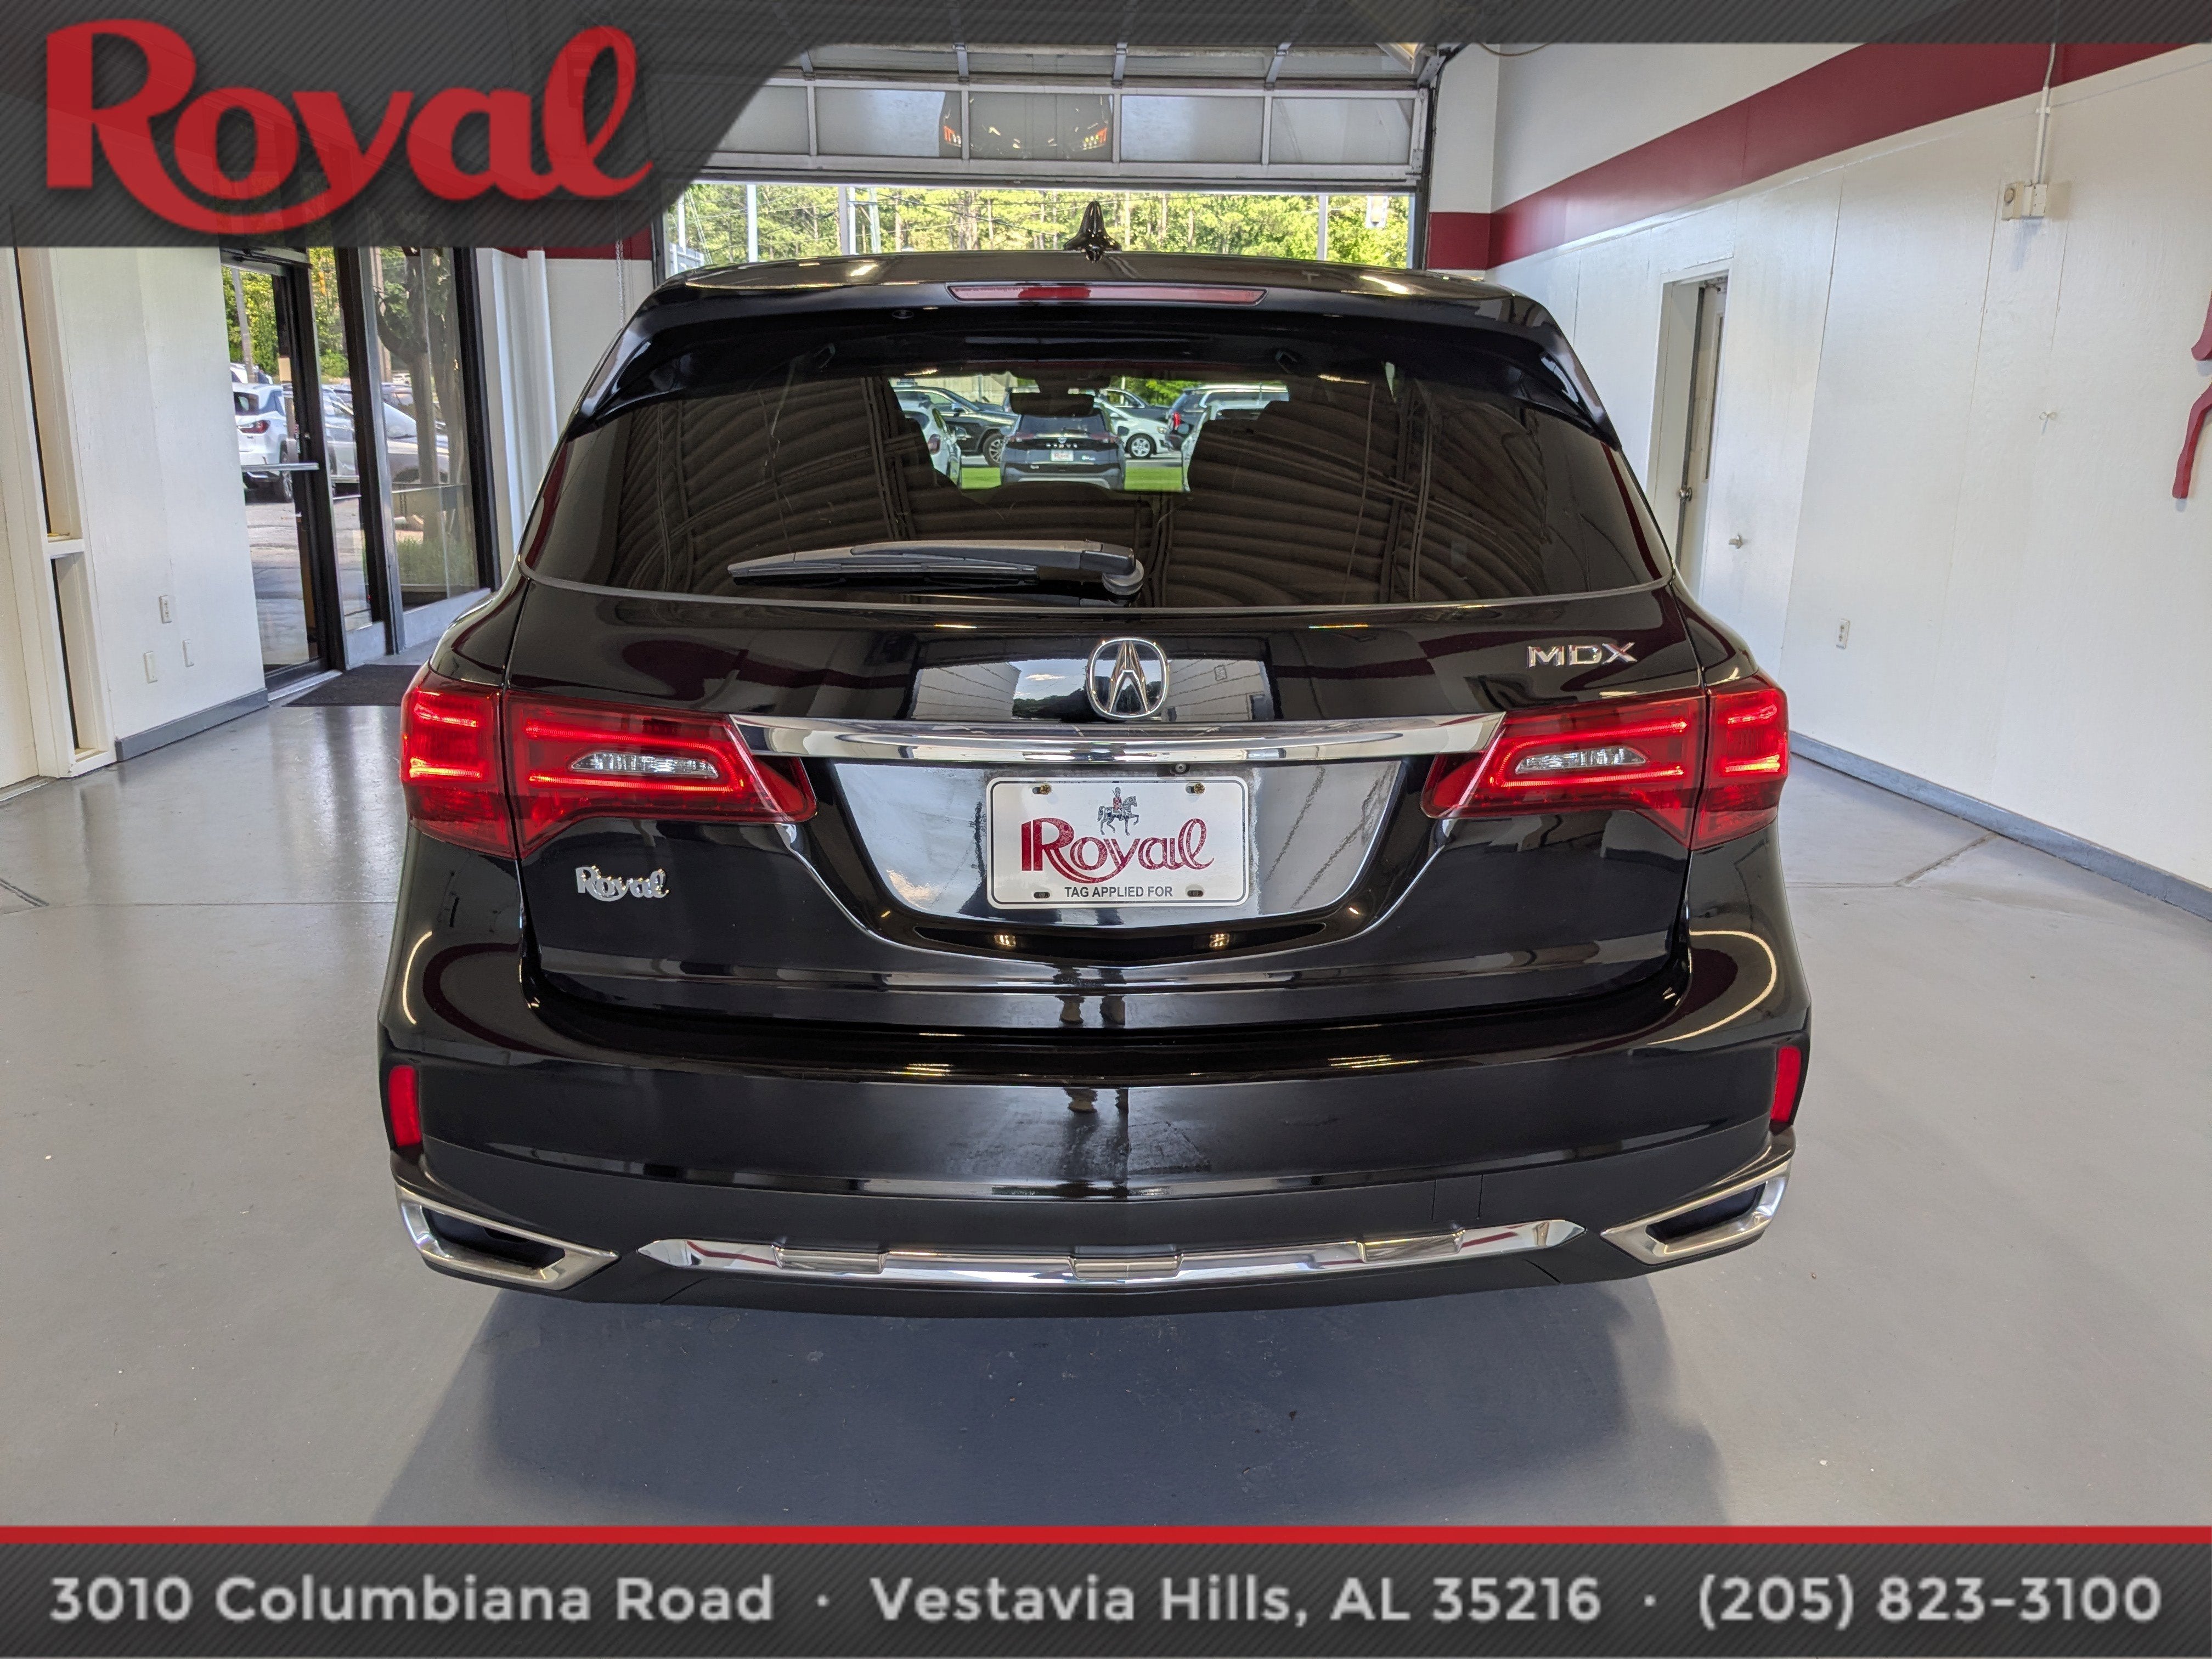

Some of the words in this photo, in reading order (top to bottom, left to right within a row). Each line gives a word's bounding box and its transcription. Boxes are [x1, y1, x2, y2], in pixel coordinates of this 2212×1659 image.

[1526, 641, 1638, 668] MDX
[1020, 817, 1215, 884] Royal
[575, 865, 670, 902] Royal
[1064, 887, 1089, 898] TAG
[1092, 887, 1144, 898] APPLIED
[1148, 886, 1173, 897] FOR
